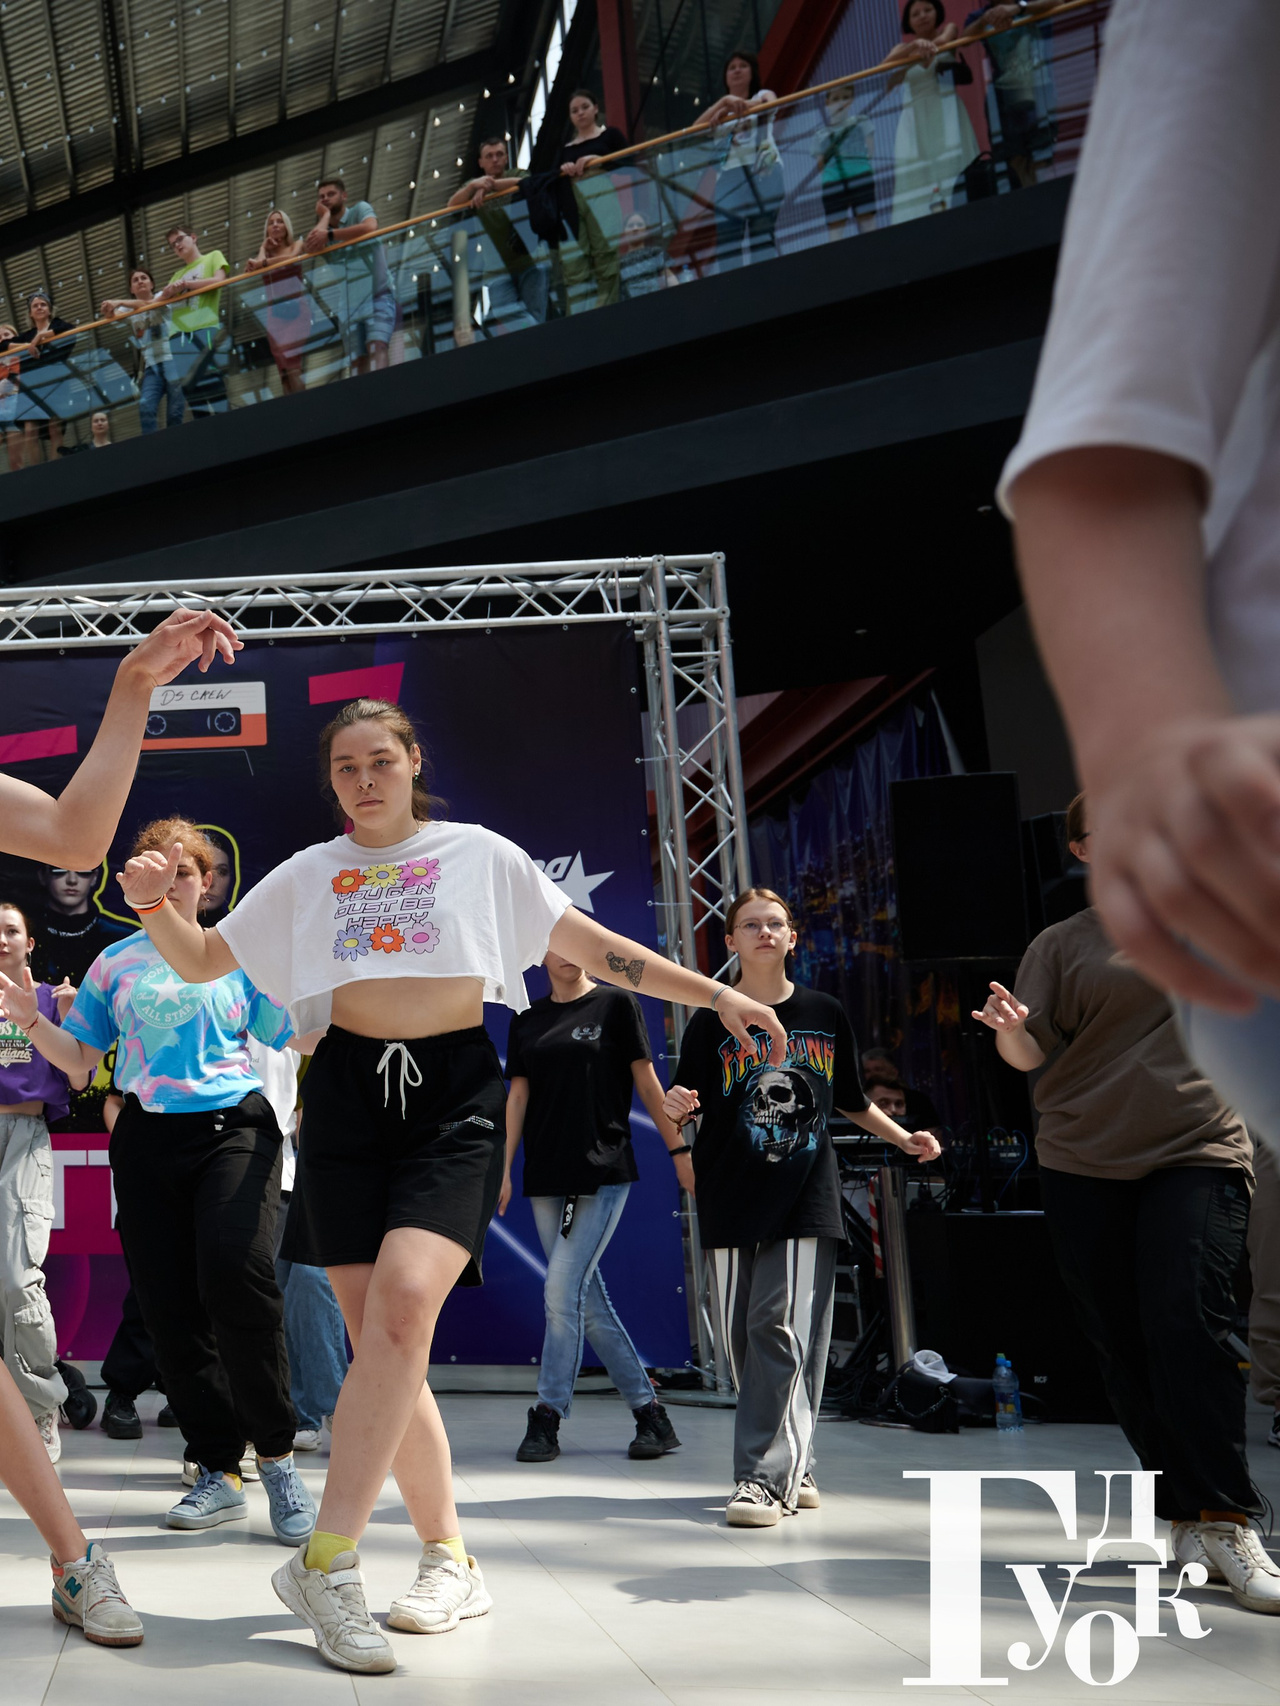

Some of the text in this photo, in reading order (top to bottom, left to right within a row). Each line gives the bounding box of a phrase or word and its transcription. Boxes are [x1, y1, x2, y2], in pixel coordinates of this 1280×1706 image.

[160, 690, 185, 706] DS
[336, 887, 383, 904] YOU
[334, 897, 435, 919] JUST BE
[141, 964, 175, 984] CONV
[142, 1003, 193, 1022] ALL STAR
